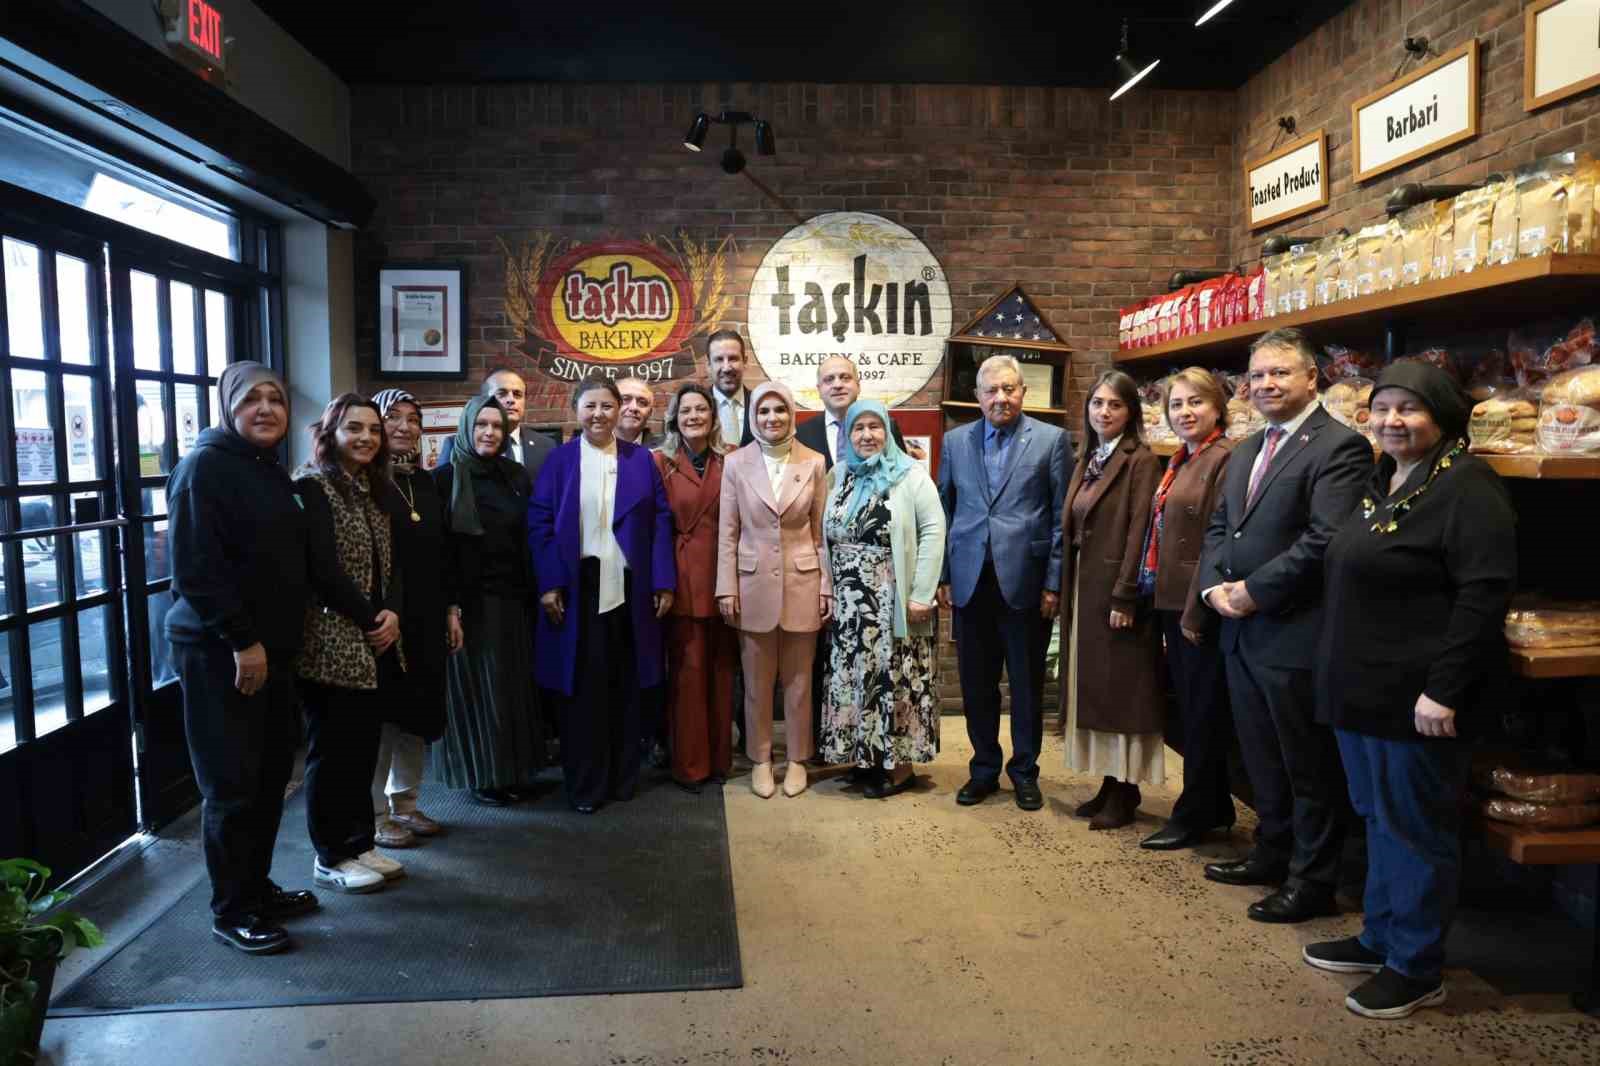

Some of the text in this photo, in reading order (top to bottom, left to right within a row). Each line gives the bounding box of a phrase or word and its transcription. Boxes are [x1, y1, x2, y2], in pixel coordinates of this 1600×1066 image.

[188, 0, 221, 59] EXIT
[1386, 94, 1438, 143] Barbari
[1249, 162, 1320, 208] Toasted Product
[579, 330, 654, 350] BAKERY
[629, 357, 674, 383] 1997
[858, 352, 872, 366] &
[877, 352, 923, 366] CAFE
[858, 370, 886, 381] 1997
